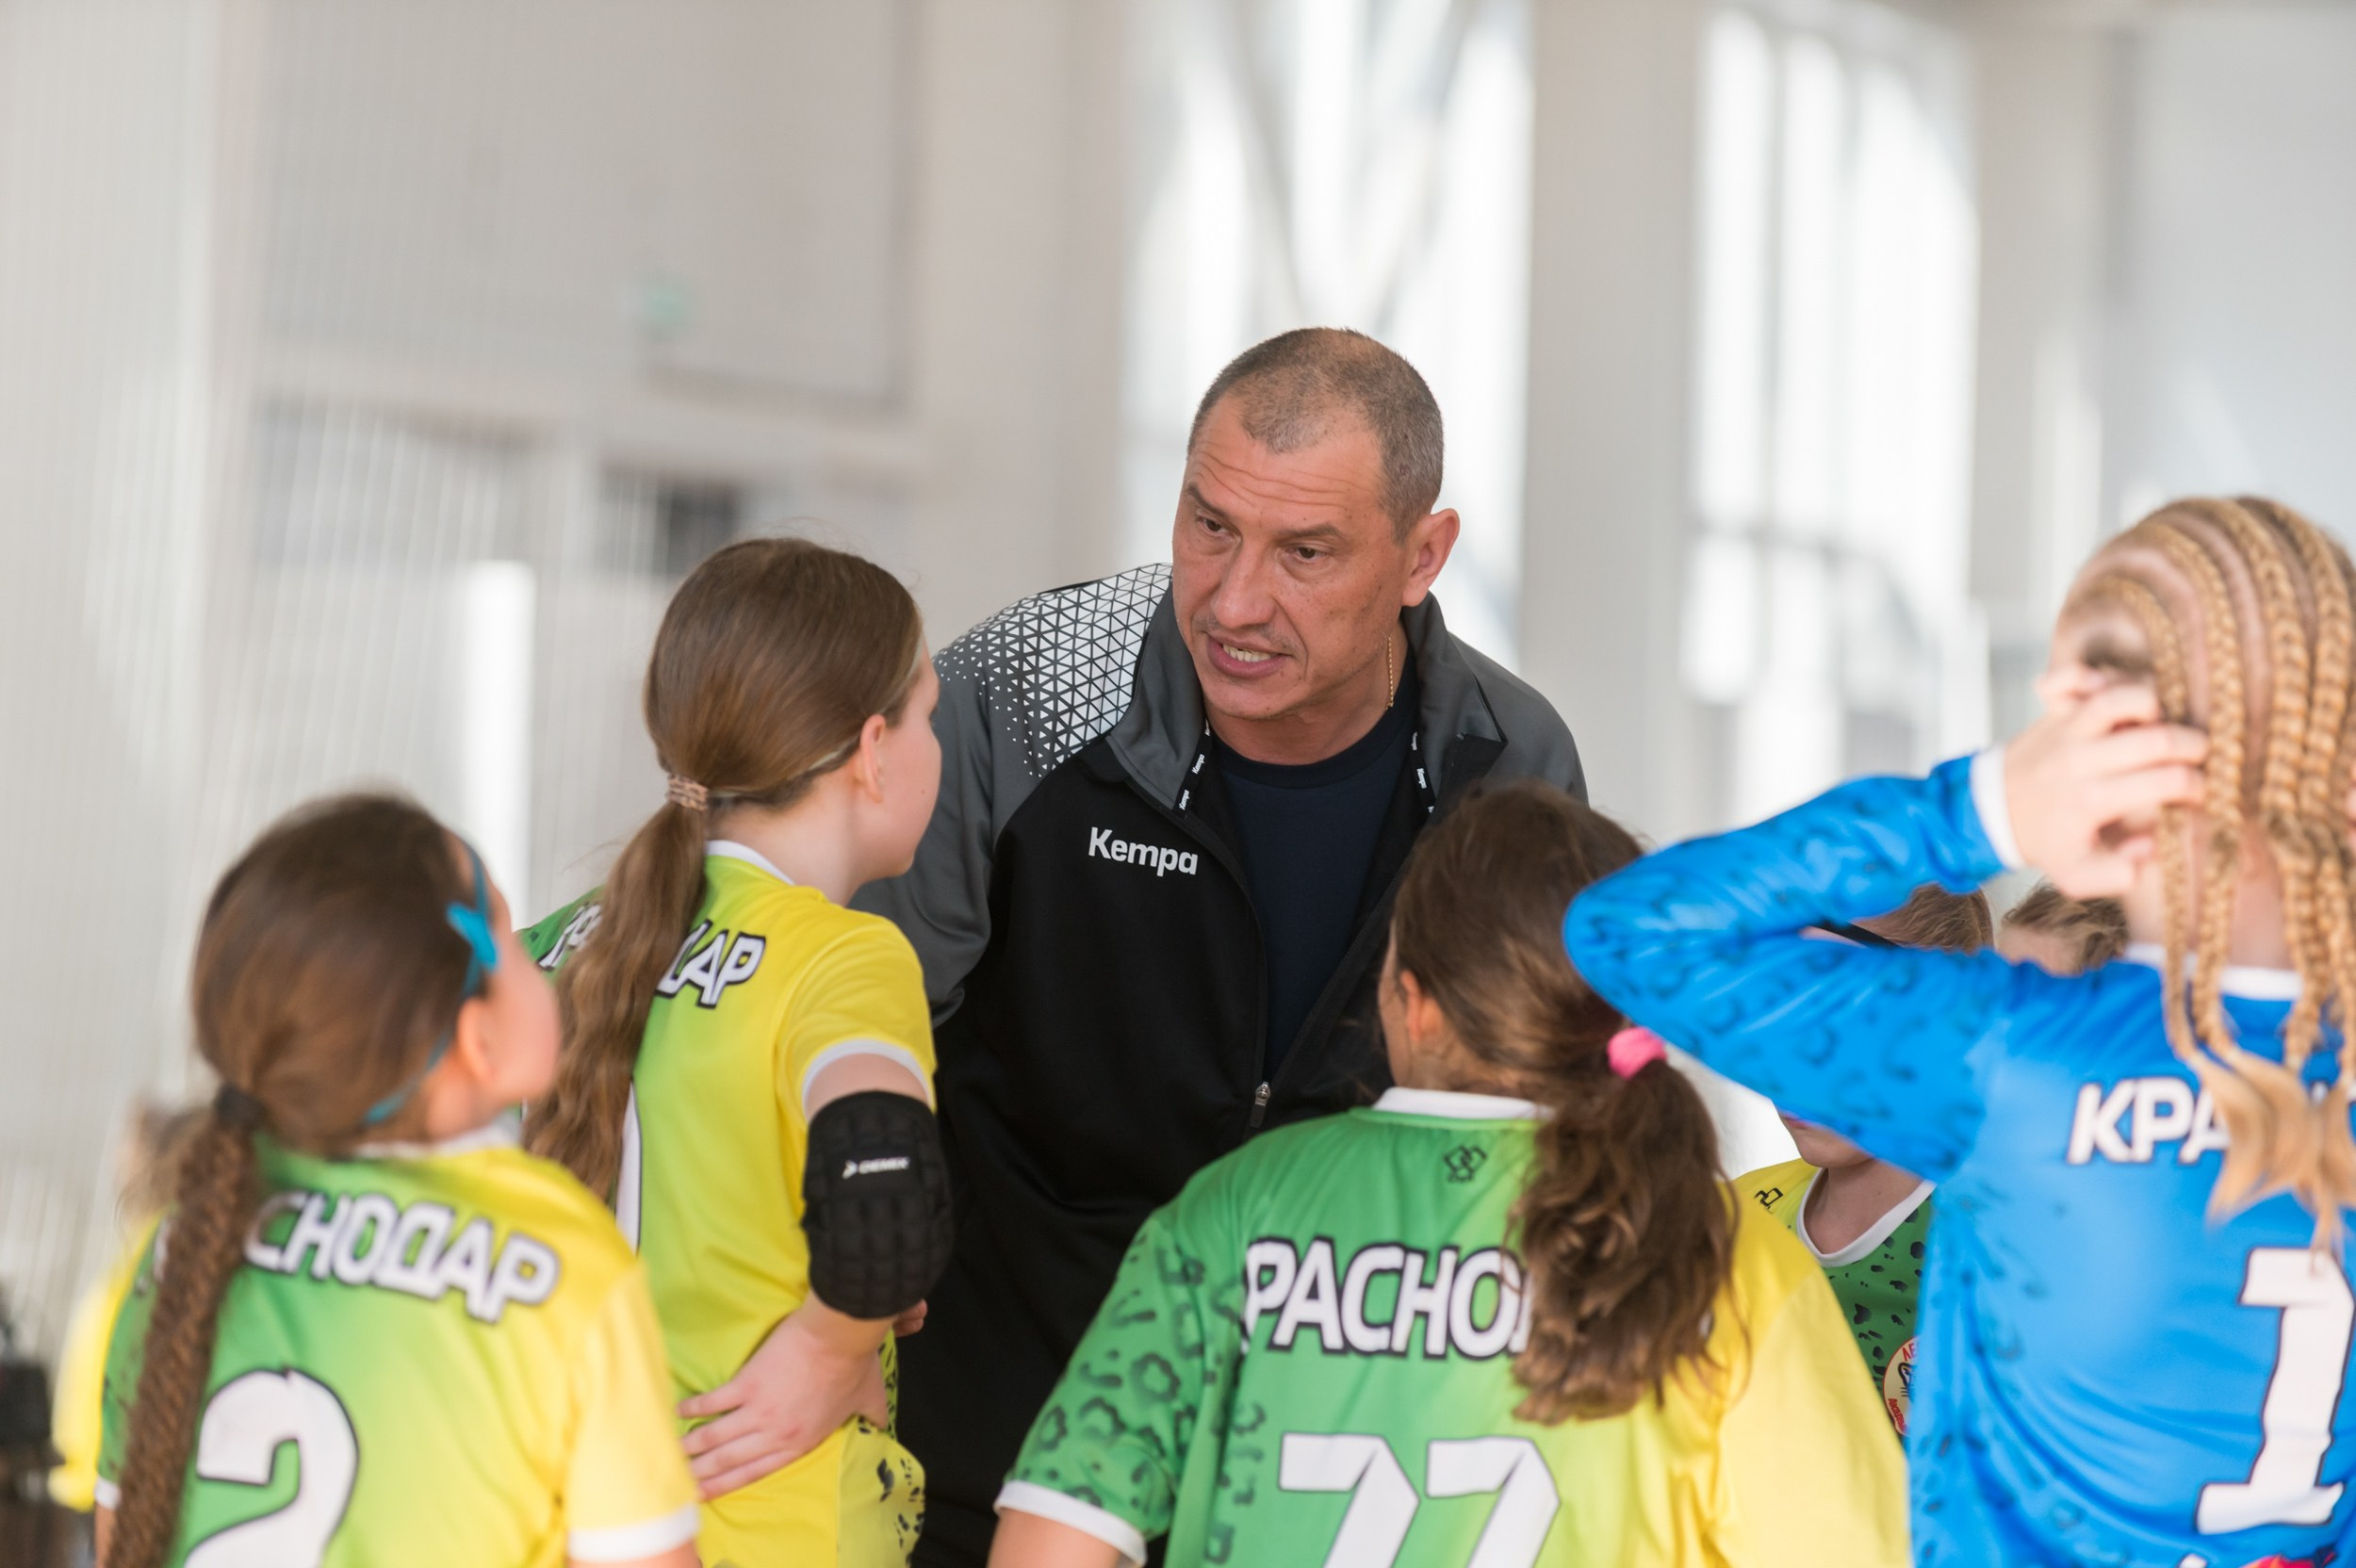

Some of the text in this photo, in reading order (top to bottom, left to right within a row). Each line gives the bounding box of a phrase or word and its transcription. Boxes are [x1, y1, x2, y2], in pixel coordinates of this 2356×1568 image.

[1088, 826, 1199, 877] Kempa
[2064, 1074, 2233, 1167] КРА
[239, 1189, 564, 1325] СНОДАР
[1238, 1234, 1533, 1361] РАСНО
[2194, 1245, 2354, 1536] 1
[181, 1368, 360, 1568] 2
